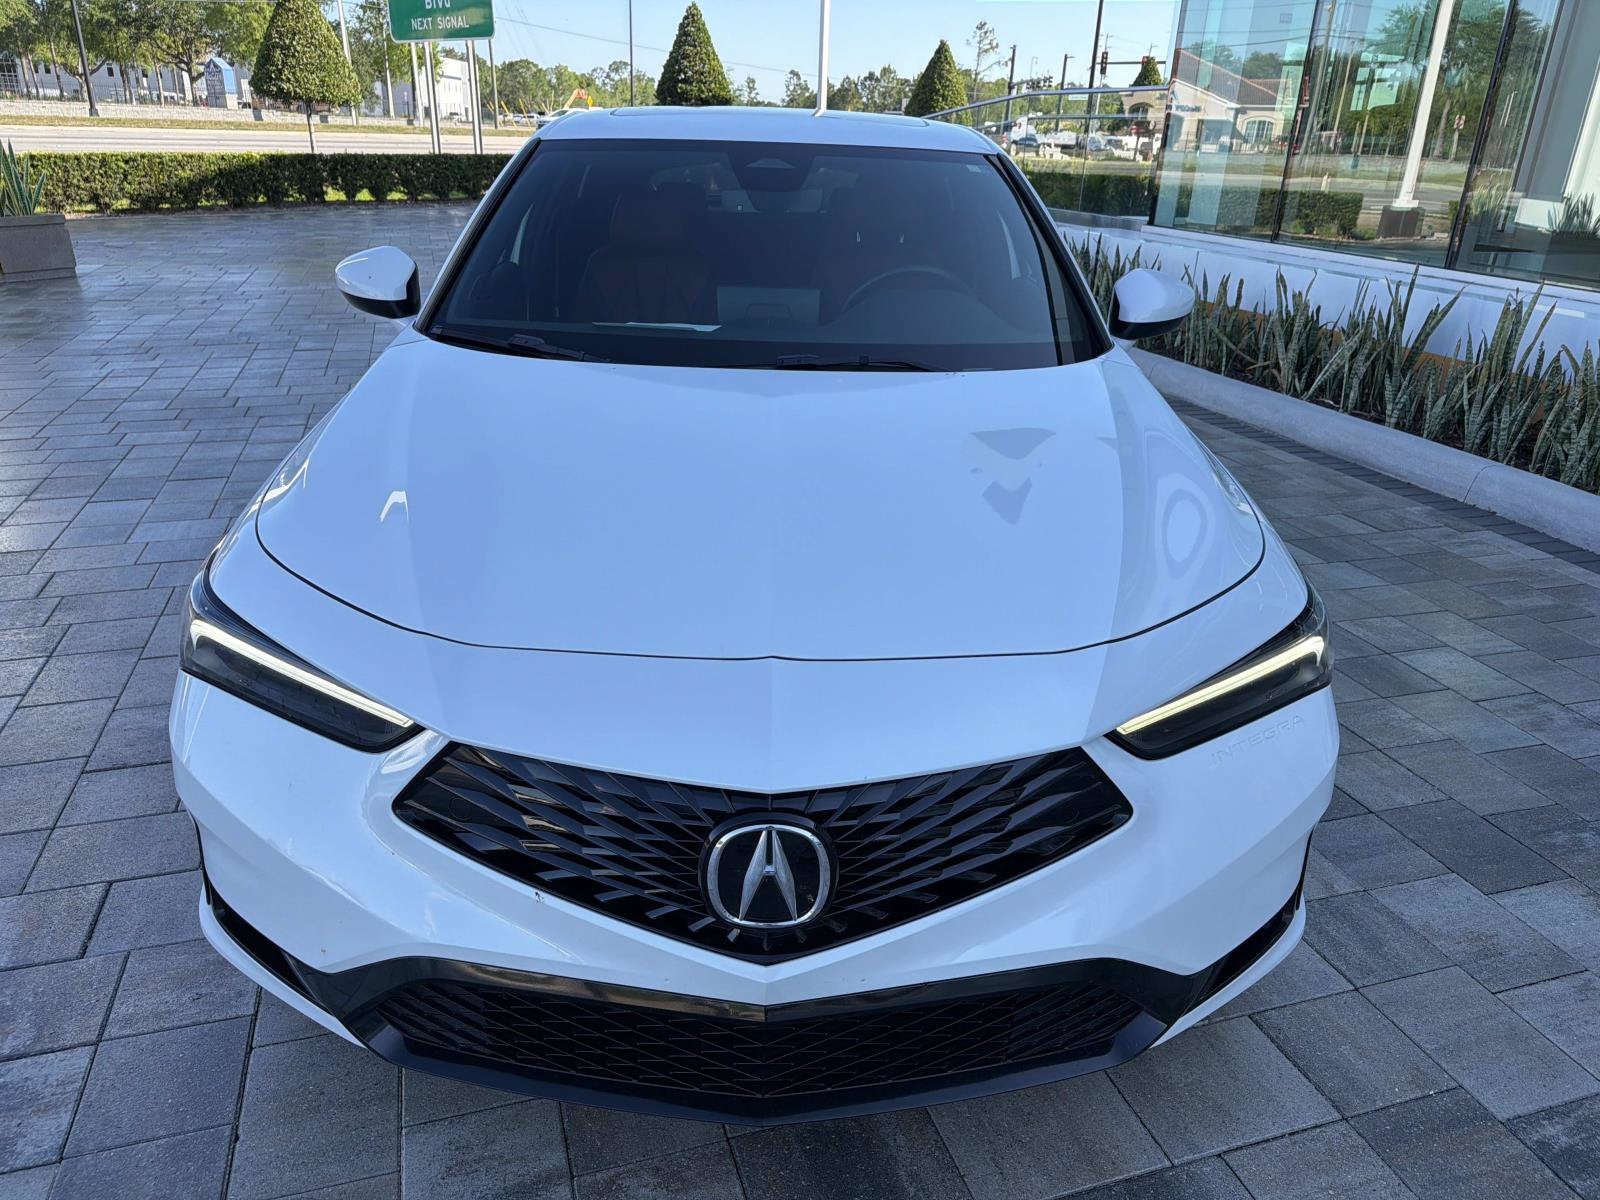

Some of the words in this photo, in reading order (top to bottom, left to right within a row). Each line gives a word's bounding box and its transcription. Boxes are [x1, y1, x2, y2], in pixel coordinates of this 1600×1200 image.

[411, 17, 432, 30] NEXT
[437, 16, 470, 29] SIGNAL
[1209, 714, 1305, 767] INTEGRA
